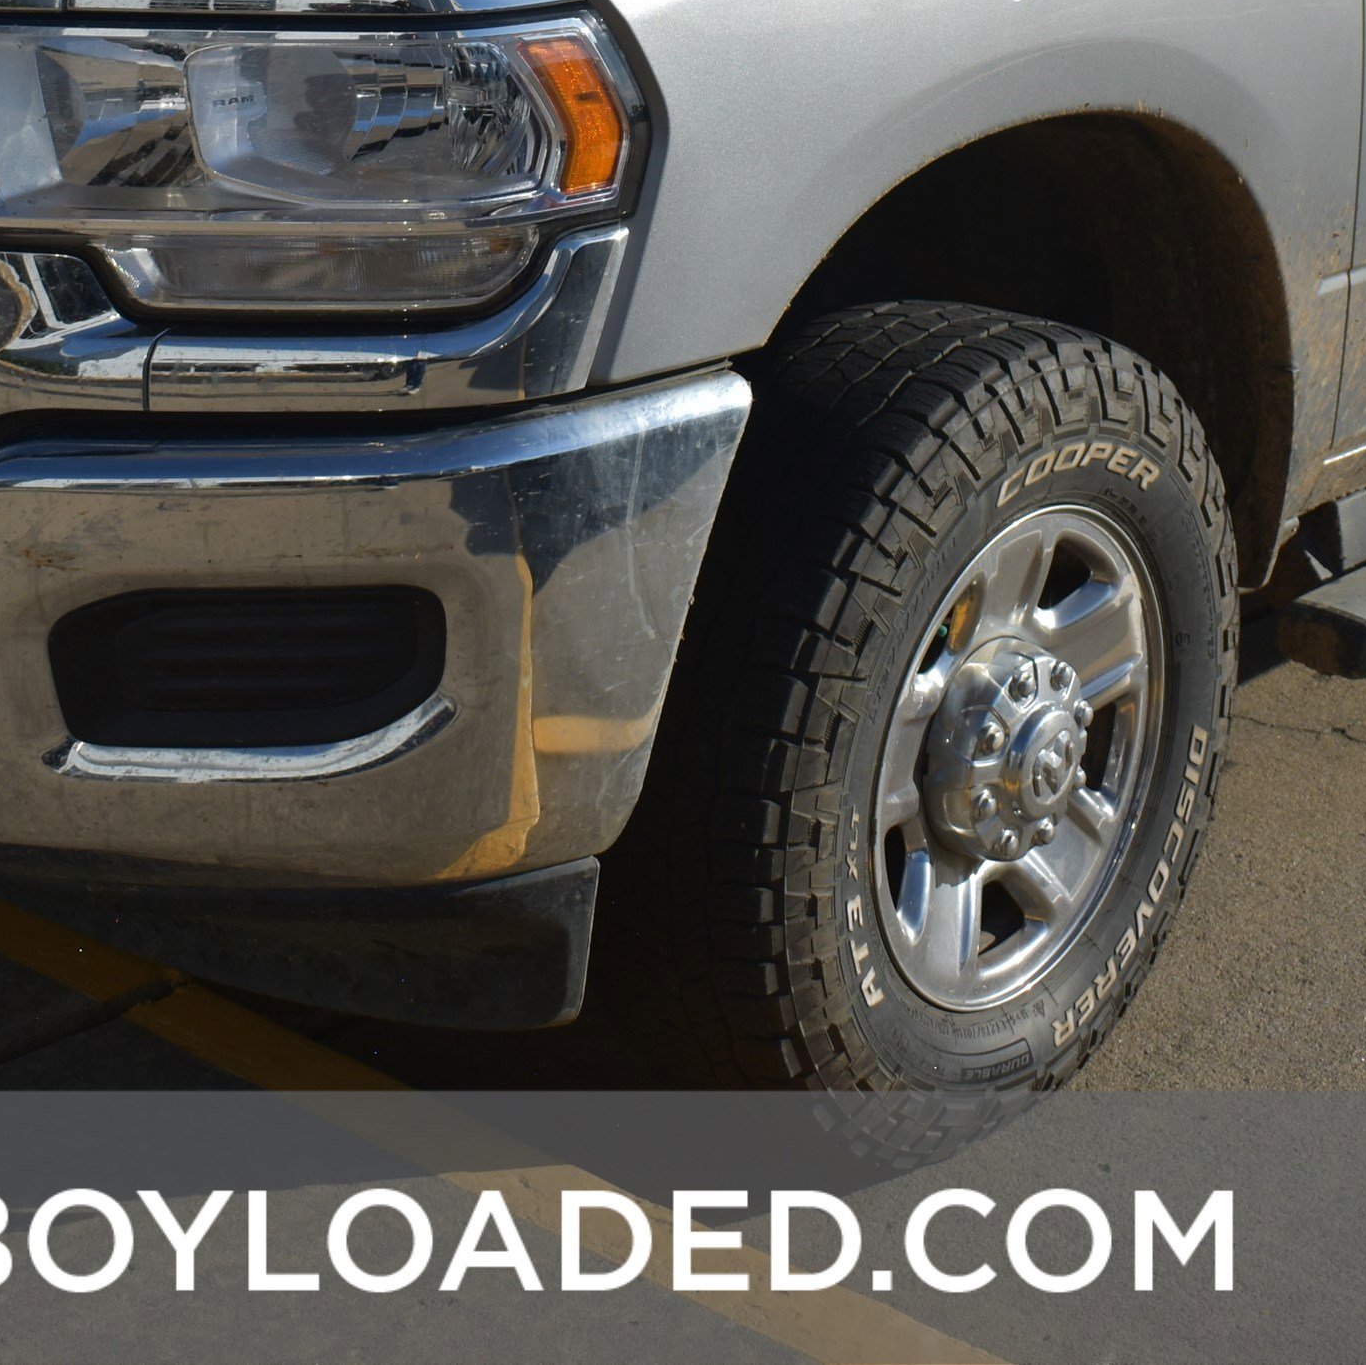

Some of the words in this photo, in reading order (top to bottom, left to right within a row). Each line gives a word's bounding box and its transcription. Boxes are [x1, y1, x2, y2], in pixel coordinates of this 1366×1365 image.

[996, 441, 1161, 508] COOPER
[1051, 723, 1208, 1048] DISCOVERER
[963, 1052, 1031, 1080] DURABLE
